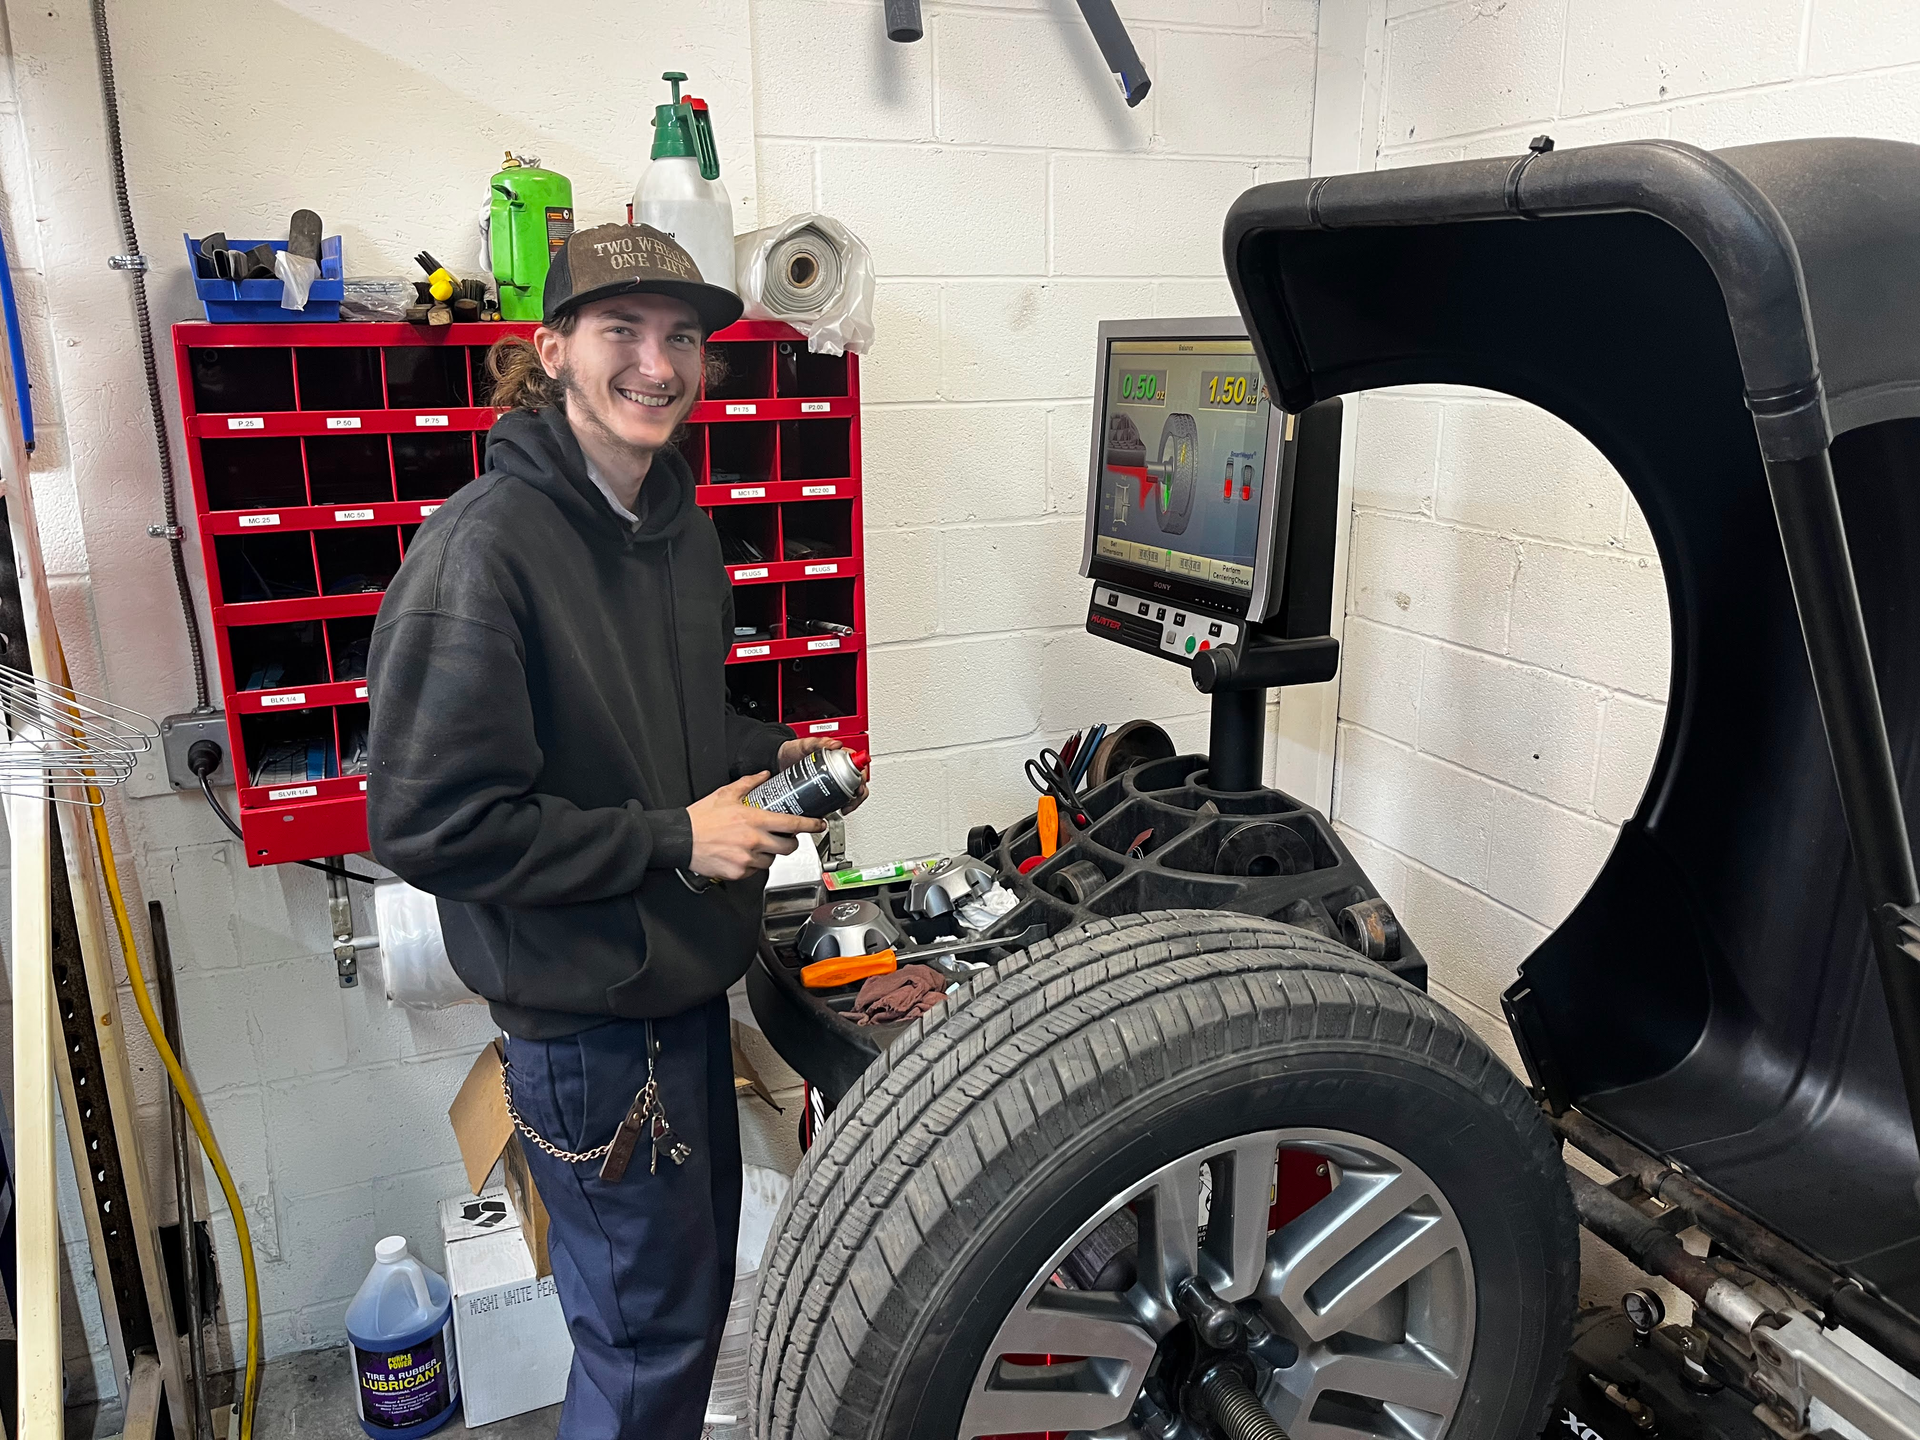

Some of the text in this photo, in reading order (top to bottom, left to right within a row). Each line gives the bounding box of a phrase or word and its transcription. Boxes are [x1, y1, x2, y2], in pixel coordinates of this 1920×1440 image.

[593, 236, 691, 269] TWO WHEELS
[611, 252, 689, 280] ONE LIFE
[1122, 373, 1165, 400] 0.50 oz
[1208, 375, 1257, 406] 1.50 oz
[741, 570, 762, 578] PLUGS
[811, 565, 831, 573] PLUGS
[1222, 564, 1241, 575] Perform
[1153, 581, 1171, 591] SONY
[1090, 614, 1122, 631] HUNTER
[744, 647, 764, 655] TOOLS
[270, 695, 297, 704] BLK 1/4
[277, 788, 309, 798] SLVR 1/4
[503, 1285, 533, 1307] WHITE
[387, 1353, 412, 1364] PURPLE
[365, 1358, 437, 1381] TIRE & RUBBER
[388, 1359, 413, 1370] POWER
[362, 1361, 442, 1391] LUBRICANT
